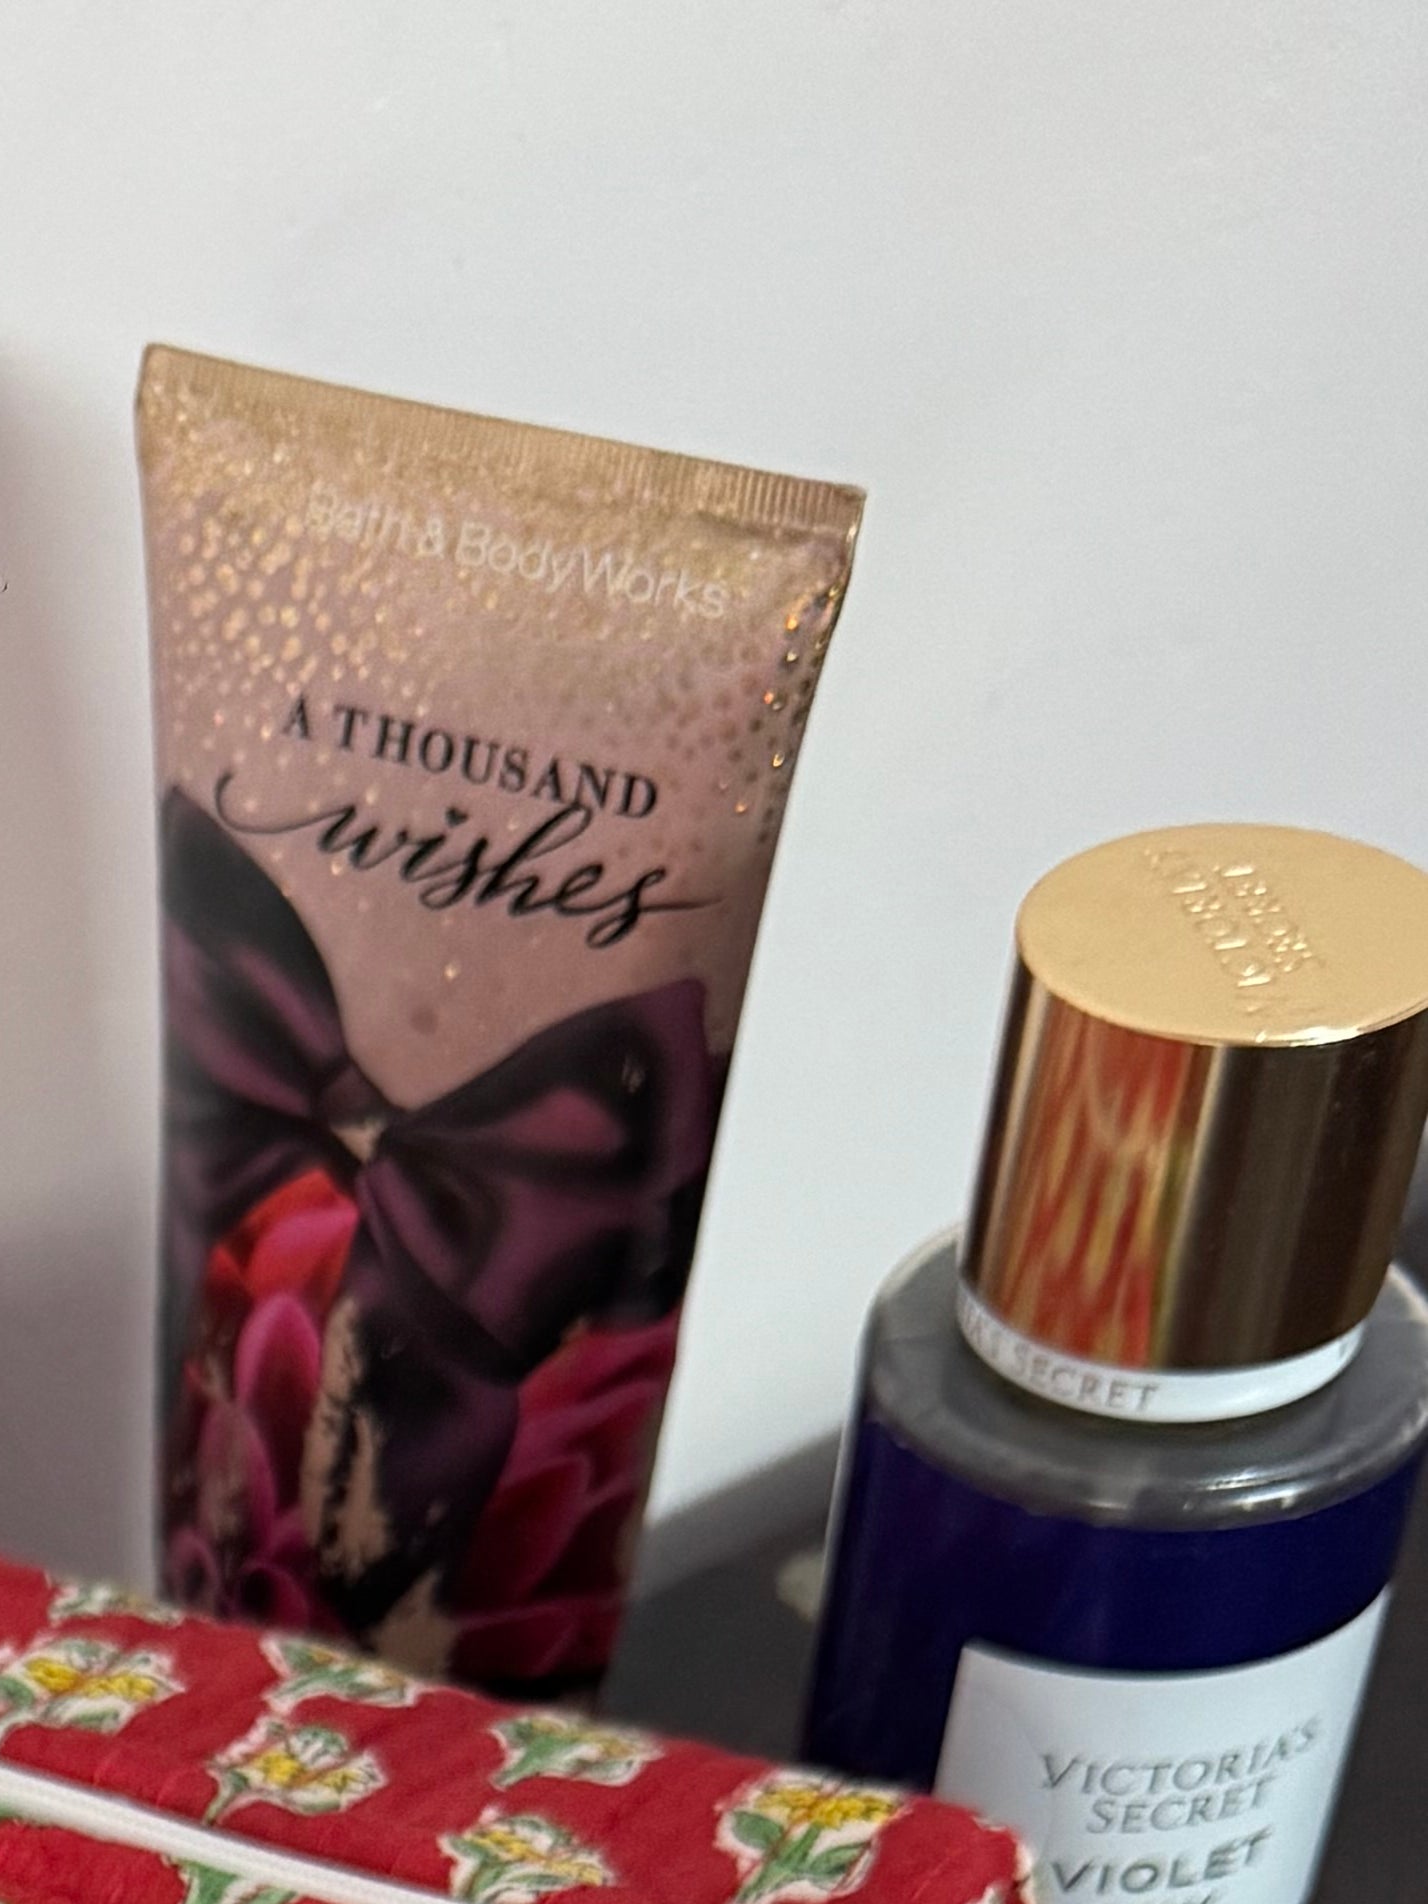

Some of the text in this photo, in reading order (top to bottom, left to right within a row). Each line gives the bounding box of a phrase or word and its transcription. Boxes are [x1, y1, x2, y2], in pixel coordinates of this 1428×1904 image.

[416, 512, 445, 562] &
[282, 694, 659, 819] A THOUSAND
[213, 768, 729, 950] wishes
[1012, 1339, 1161, 1415] SECRET
[1040, 1715, 1322, 1797] VICTORIA'S
[1086, 1772, 1278, 1834] SECRET
[1051, 1825, 1273, 1894] VIOLET
